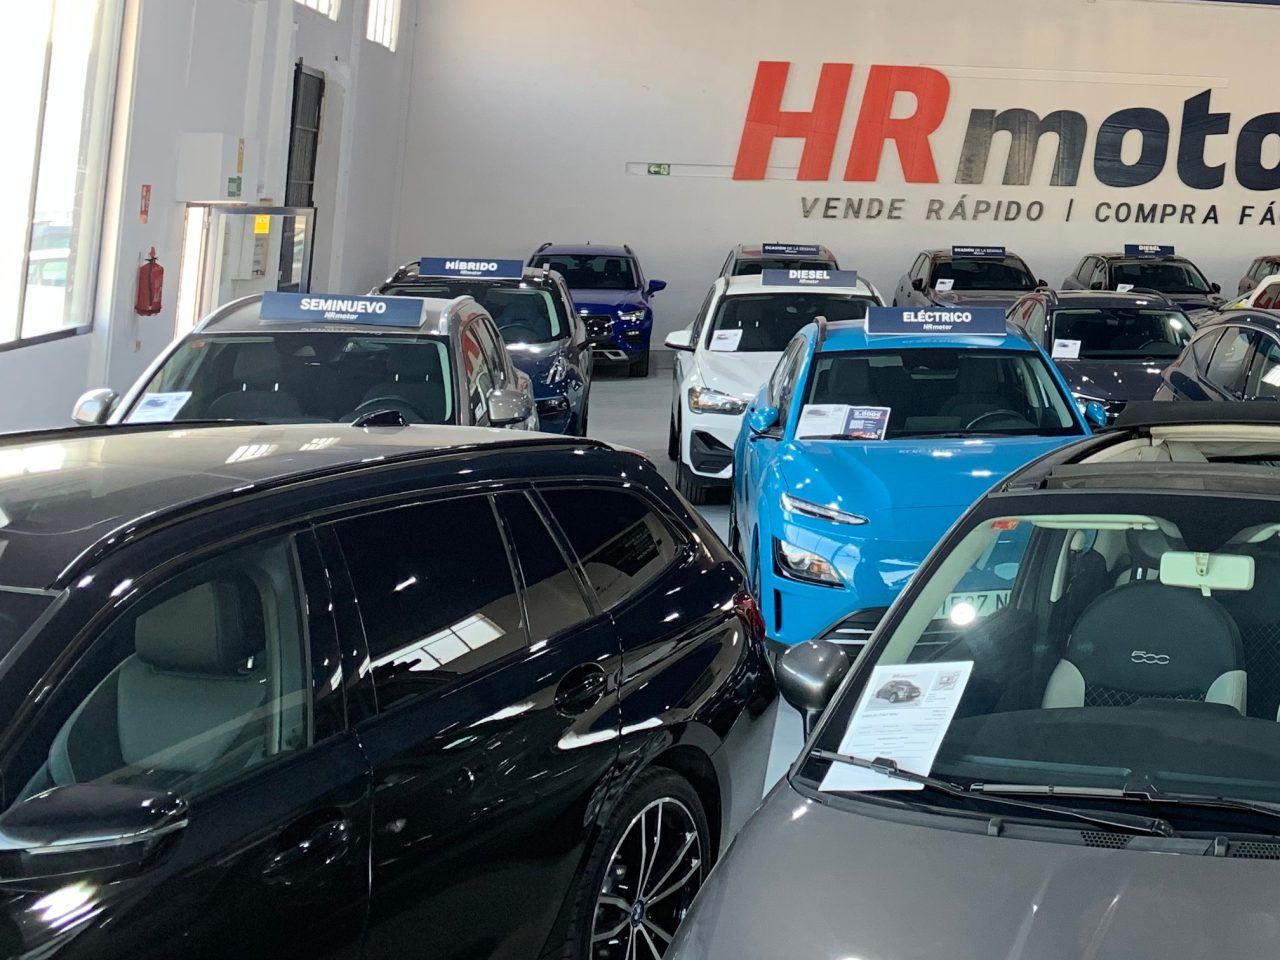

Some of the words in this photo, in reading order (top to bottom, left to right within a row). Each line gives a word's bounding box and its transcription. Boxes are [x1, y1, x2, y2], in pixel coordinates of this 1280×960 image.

[800, 196, 906, 220] VENDE
[925, 192, 1046, 222] RÁPIDO
[1094, 200, 1220, 226] COMPRA
[445, 259, 498, 271] HÍBRIDO
[788, 269, 831, 279] DIESEL
[300, 298, 387, 314] SEMINUEVO
[902, 309, 972, 322] ELÉCTRICO
[1131, 650, 1170, 664] 500
